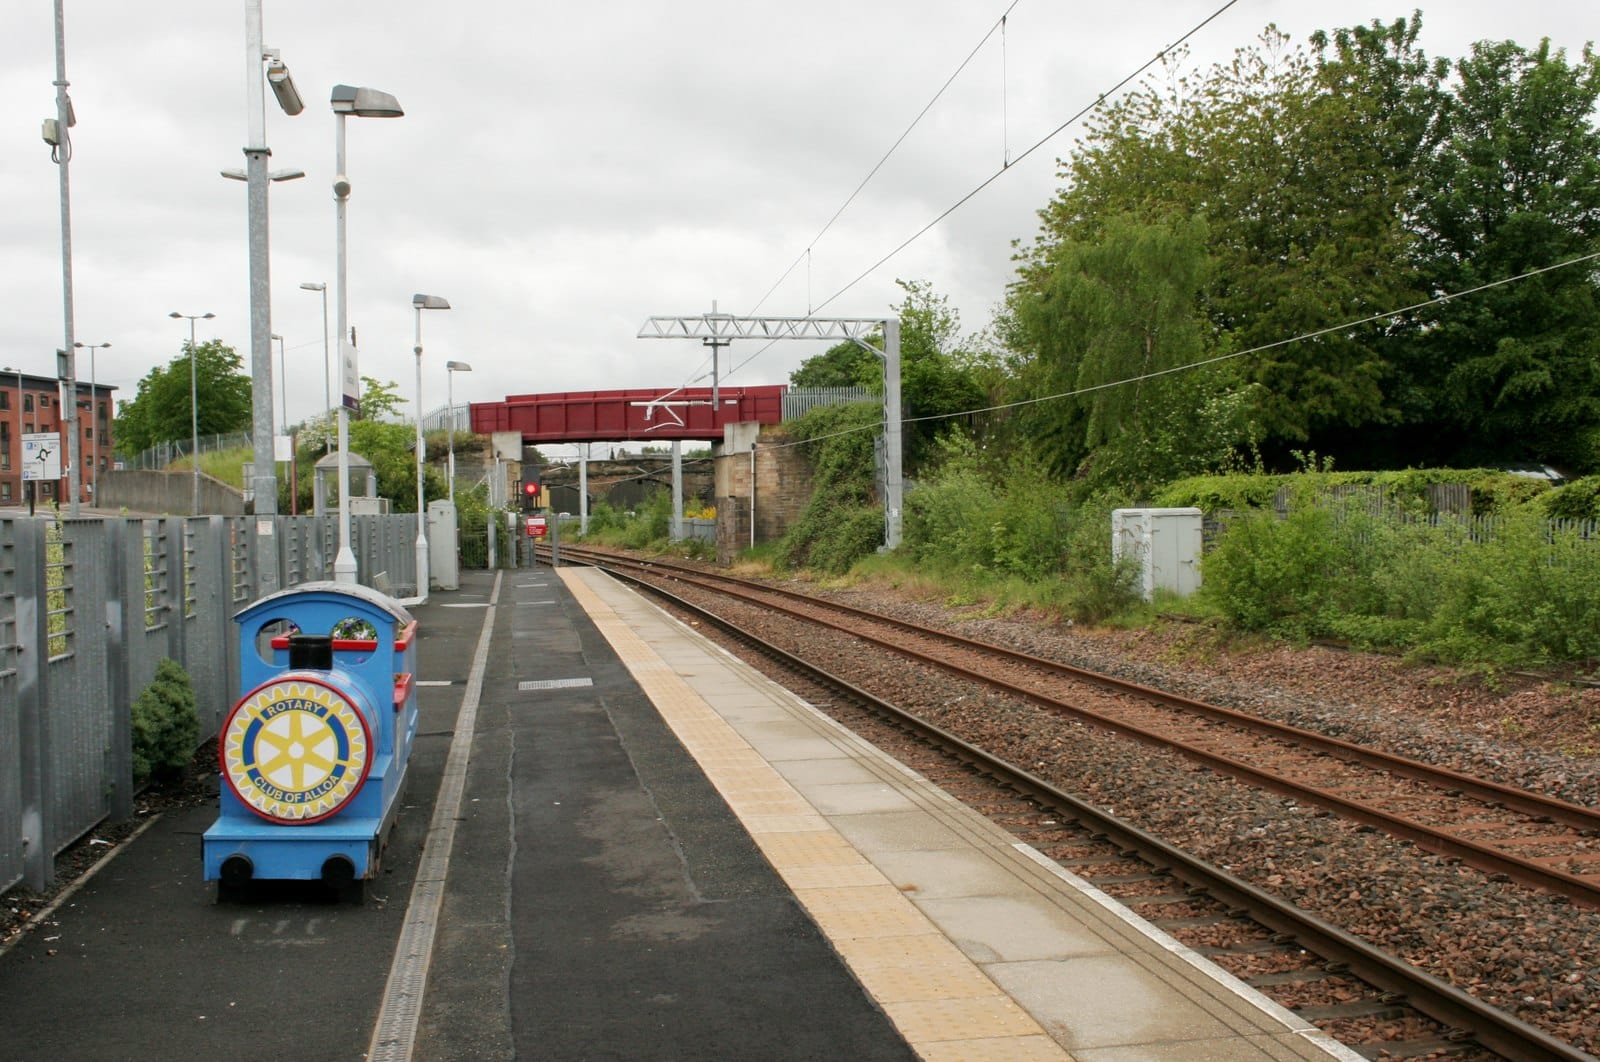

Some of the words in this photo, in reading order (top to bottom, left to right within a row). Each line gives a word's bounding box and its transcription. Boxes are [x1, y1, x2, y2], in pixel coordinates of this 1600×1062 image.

[268, 700, 322, 716] ROTARY
[254, 776, 283, 800] CLUB
[285, 792, 302, 802] OF
[304, 775, 339, 801] ALLOA
